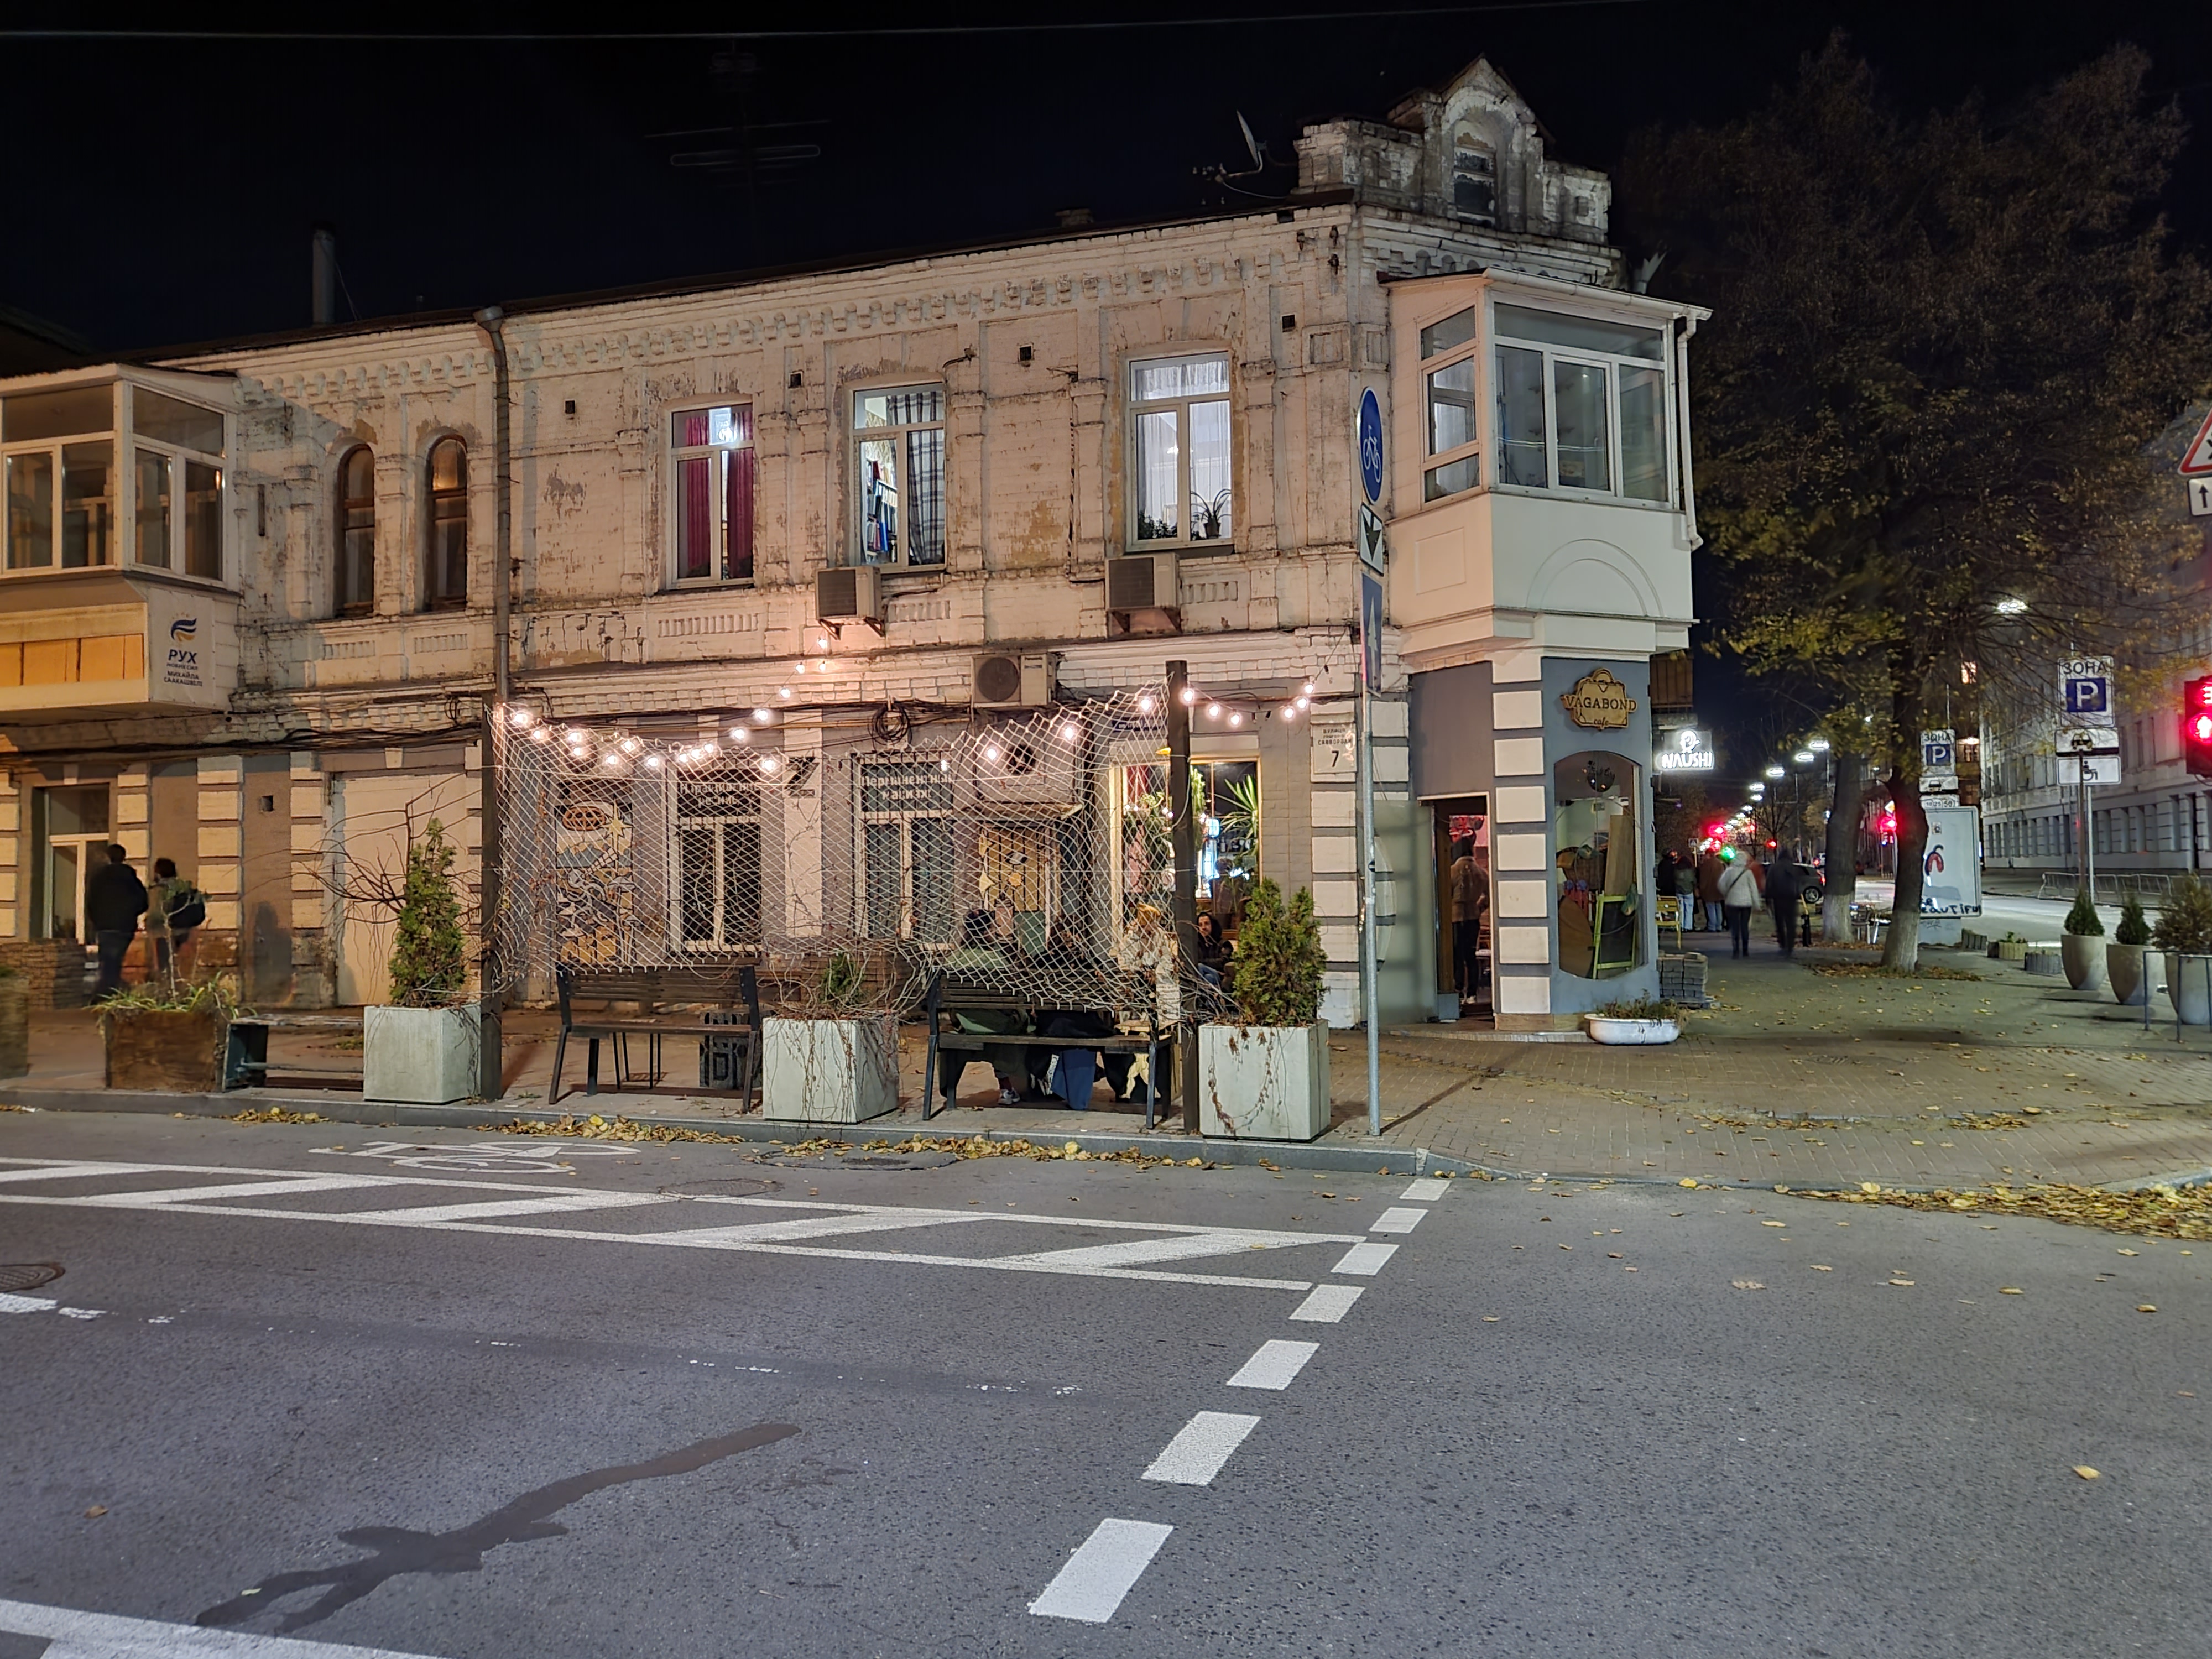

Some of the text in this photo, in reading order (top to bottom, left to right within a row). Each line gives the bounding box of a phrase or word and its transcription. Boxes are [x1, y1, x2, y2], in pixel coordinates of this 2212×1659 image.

[169, 649, 197, 664] РУХ
[167, 670, 199, 680] МИХАЙЛА
[2063, 661, 2107, 674] ЗОНА
[1564, 696, 1637, 711] VAGABOND
[1924, 733, 1952, 742] ЗОНА
[1331, 750, 1339, 768] 7
[1661, 751, 1713, 769] NAUSHI
